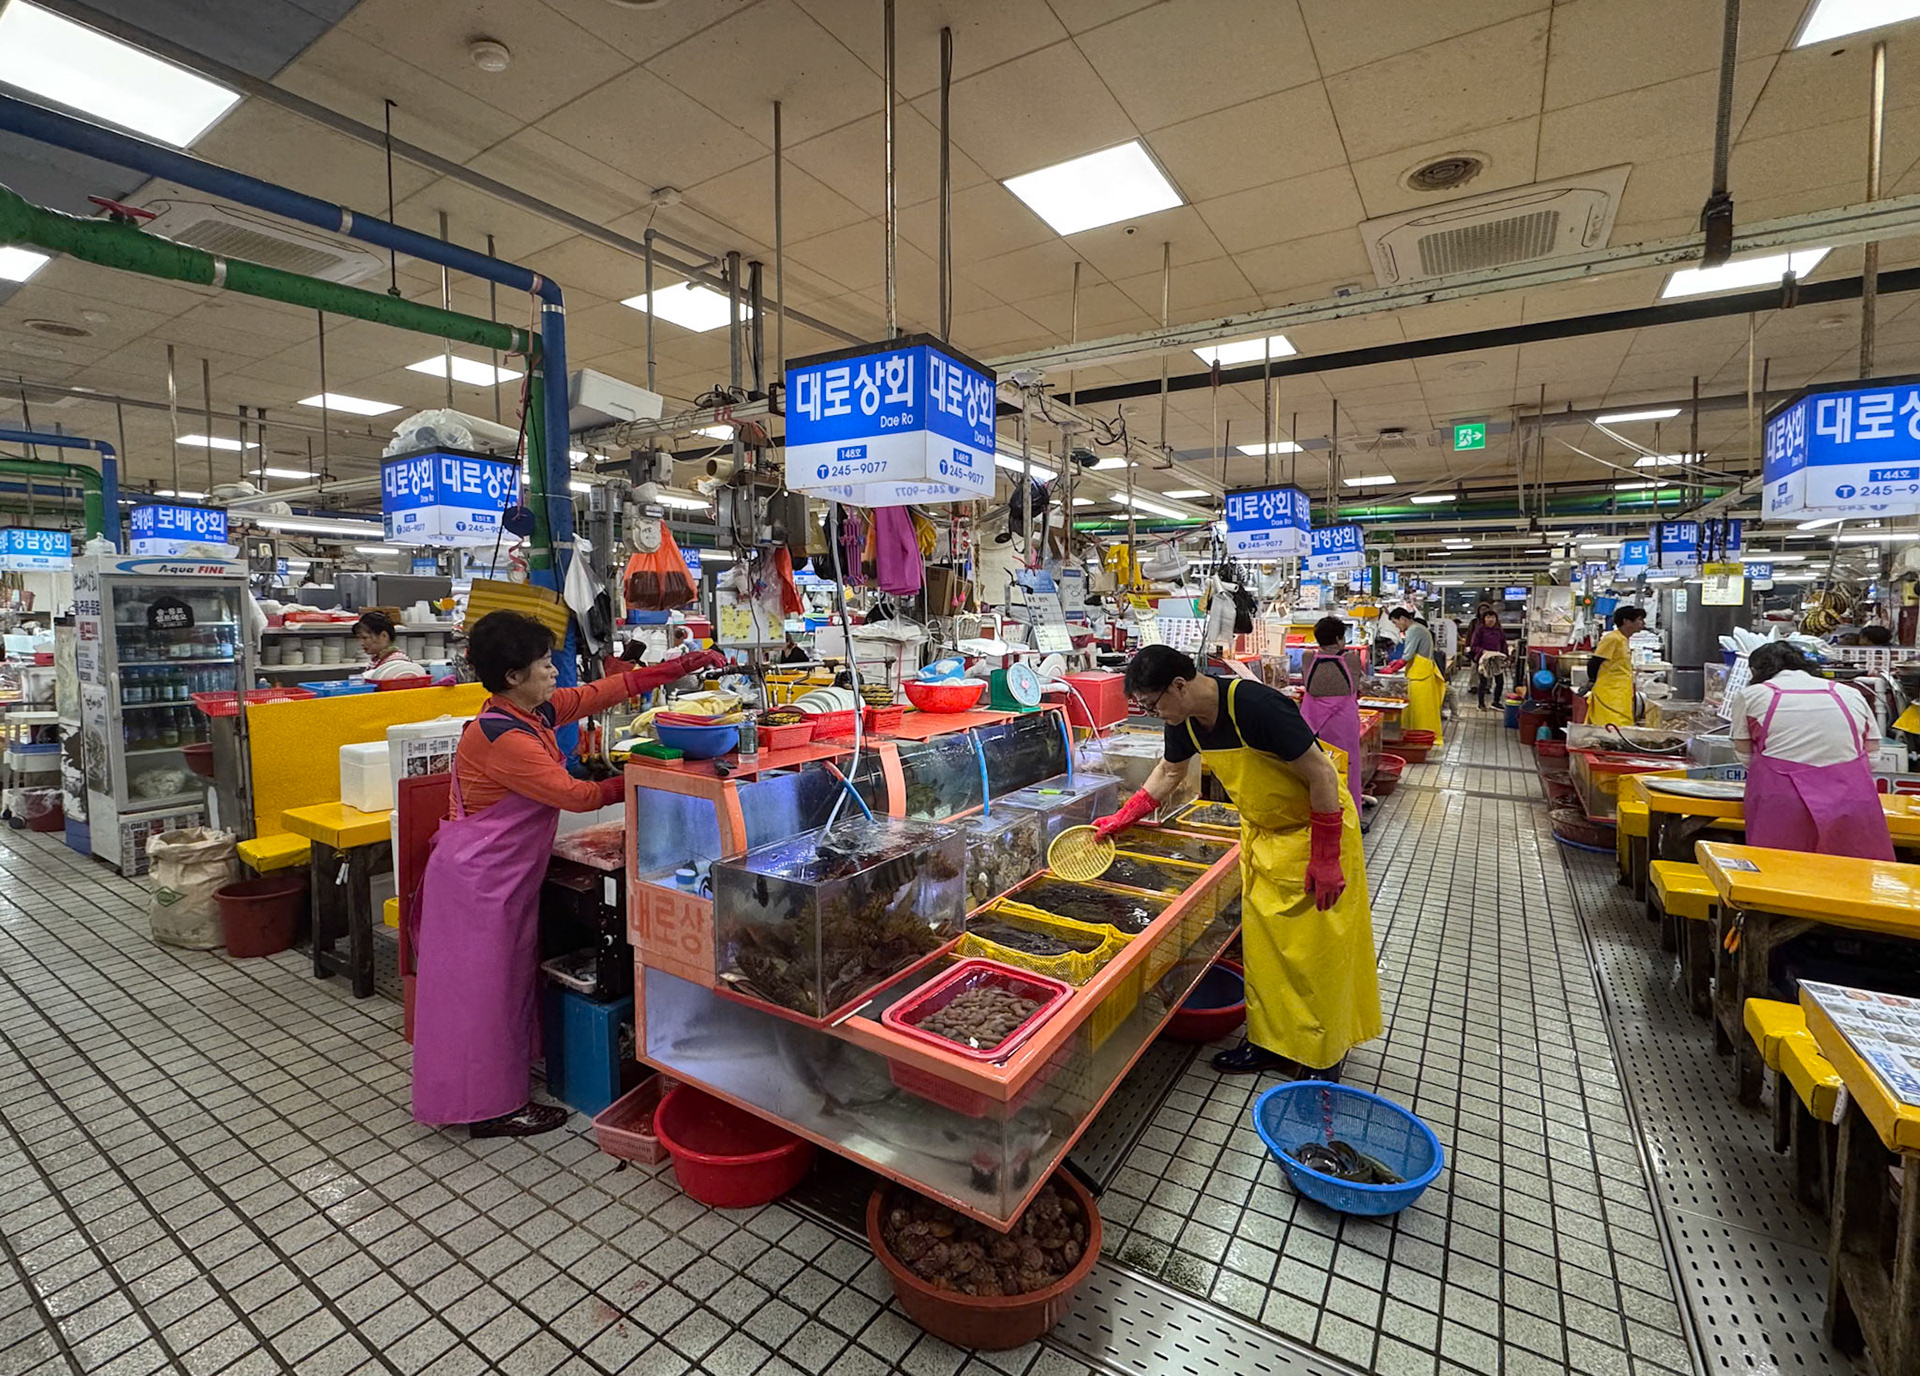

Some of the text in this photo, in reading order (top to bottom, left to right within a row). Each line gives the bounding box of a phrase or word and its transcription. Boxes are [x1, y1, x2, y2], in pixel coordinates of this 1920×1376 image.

[796, 355, 914, 422] 대로상회
[930, 355, 994, 433] 대로상회
[880, 412, 914, 429] Dae Ro
[974, 430, 993, 448] Dae Ro
[1767, 404, 1806, 464] 대로상회
[840, 447, 862, 460] 148호
[385, 458, 434, 498] 대로상회
[441, 458, 520, 500] 대로상회
[831, 461, 888, 478] 245-9077
[949, 465, 985, 486] 245-9077
[1876, 469, 1911, 480] 144호
[1228, 491, 1292, 522] 대로상회
[157, 507, 225, 535] 보배상회
[12, 531, 68, 552] 경남상회
[1247, 540, 1283, 549] 245-9077
[1311, 526, 1355, 549] 대영상회
[198, 565, 226, 575] FINE
